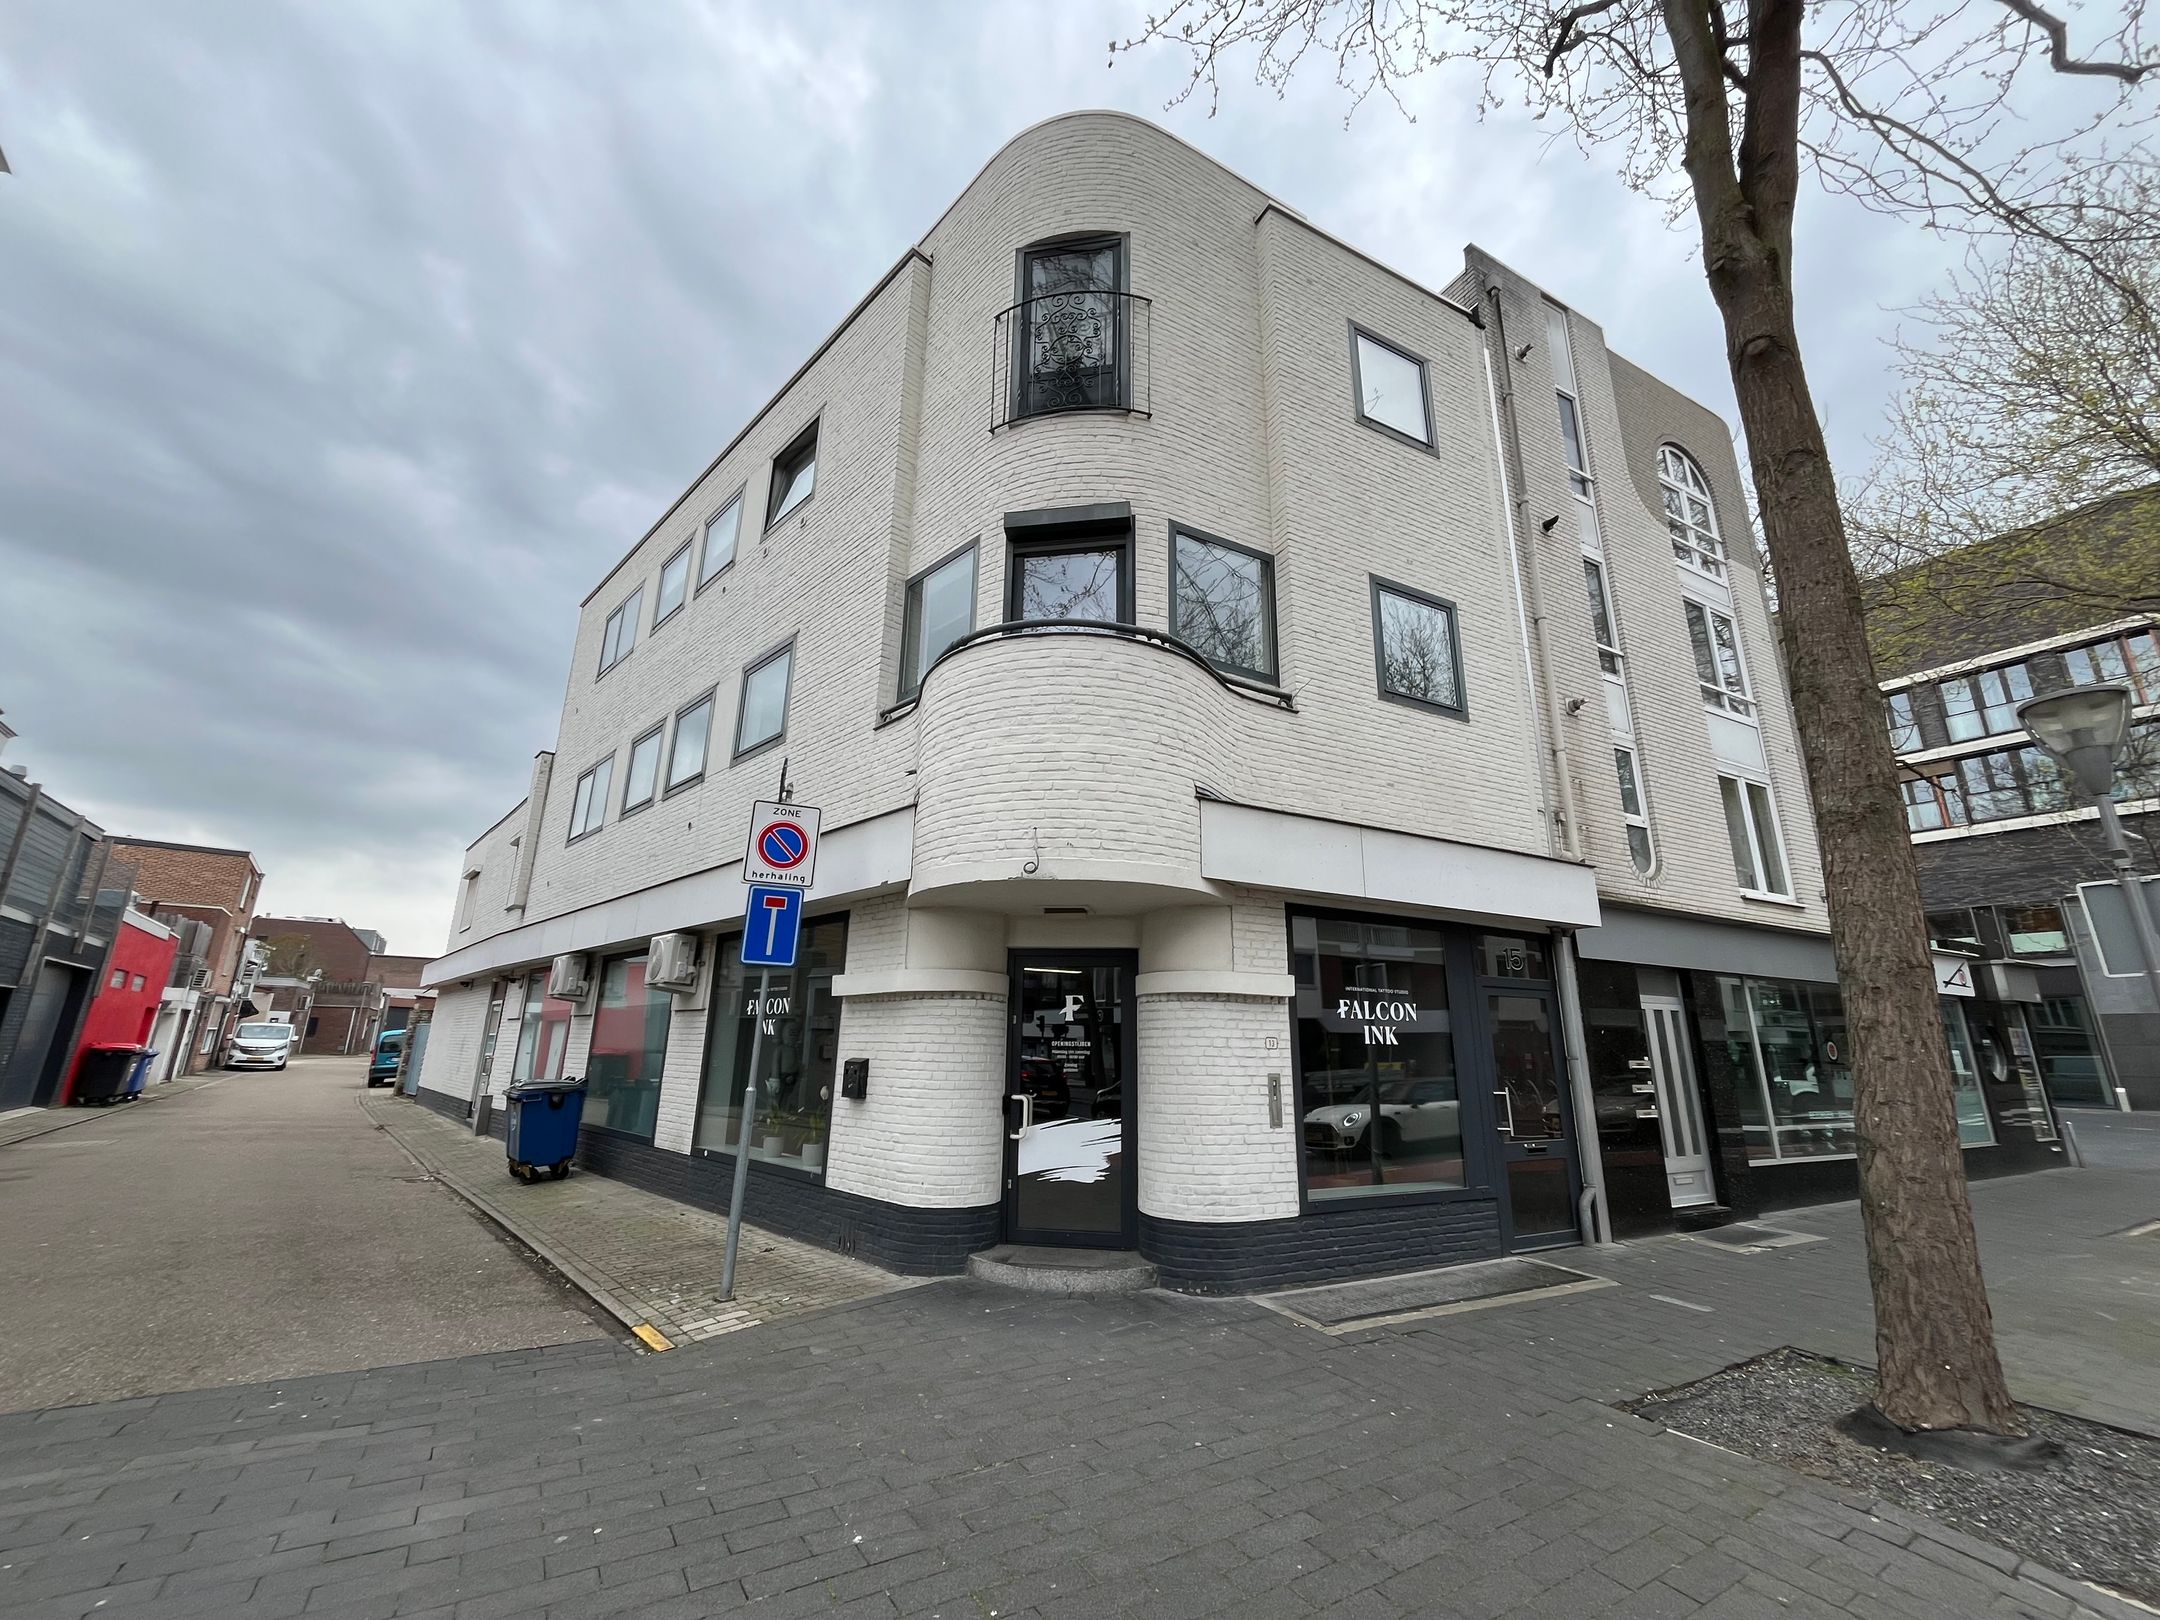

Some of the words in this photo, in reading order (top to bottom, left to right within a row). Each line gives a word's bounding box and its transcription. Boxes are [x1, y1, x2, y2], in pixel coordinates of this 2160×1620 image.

[773, 807, 802, 818] ZONE
[752, 870, 806, 884] herhaling
[1502, 947, 1524, 971] 15
[746, 998, 791, 1015] FACON
[1059, 995, 1085, 1021] F
[1337, 999, 1418, 1022] FALCON
[762, 1019, 776, 1036] NK
[1363, 1025, 1399, 1045] INK
